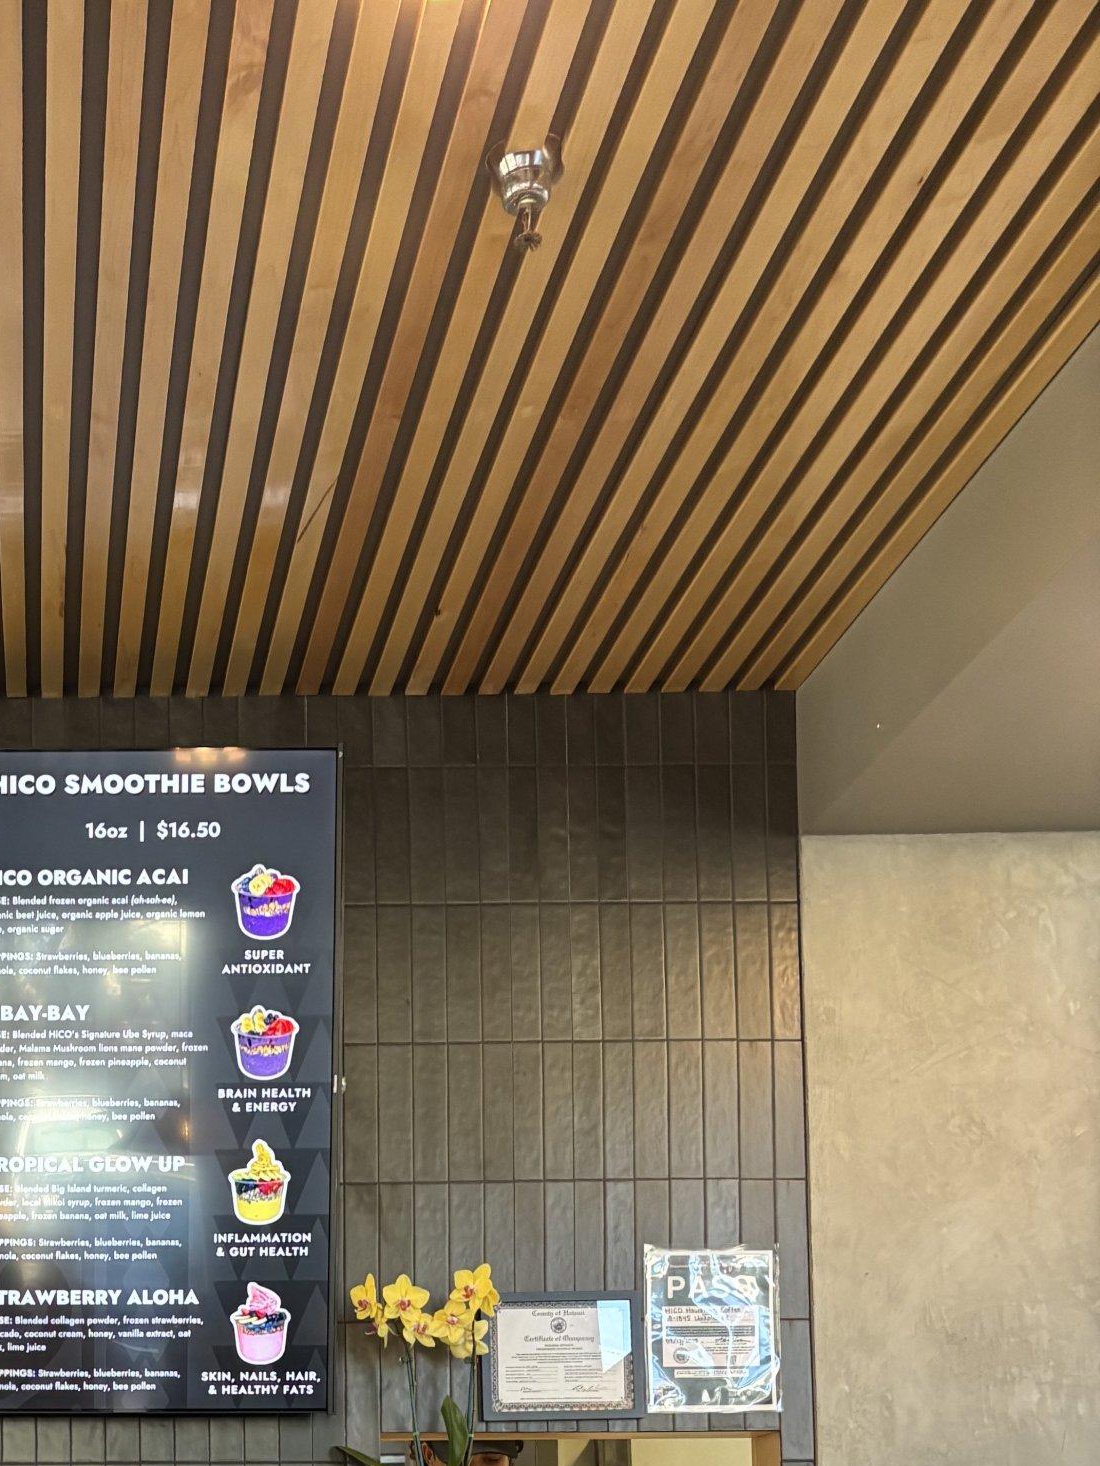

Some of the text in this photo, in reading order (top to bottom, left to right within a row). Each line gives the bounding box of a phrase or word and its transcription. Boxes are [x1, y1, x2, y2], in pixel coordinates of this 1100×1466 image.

[64, 774, 205, 795] SMOOTHIE
[214, 773, 310, 794] BOWLS
[86, 821, 221, 839] 16oz $16.50
[38, 869, 131, 885] ORGANIC
[137, 869, 188, 885] ACAI
[16, 910, 34, 919] beet
[36, 910, 59, 920] juice,
[62, 910, 93, 920] organic
[95, 910, 118, 920] apple
[120, 909, 143, 920] juice,
[146, 909, 177, 920] organic
[180, 909, 205, 918] lemon
[244, 950, 284, 959] SUPER
[222, 964, 310, 974] ANTIOXIDANT
[218, 1088, 310, 1099] BRAIN HEALTH
[232, 1102, 297, 1112] & ENERGY
[89, 1157, 154, 1172] GLOW
[159, 1157, 185, 1172] UP
[214, 1233, 311, 1244] INFLAMMATION
[216, 1247, 308, 1257] & GUT HEALTH
[127, 1289, 199, 1305] ALOHA
[201, 1372, 321, 1383] SKIN, NAILS, HAIR,
[208, 1385, 313, 1395] & HEALTHY FATS
